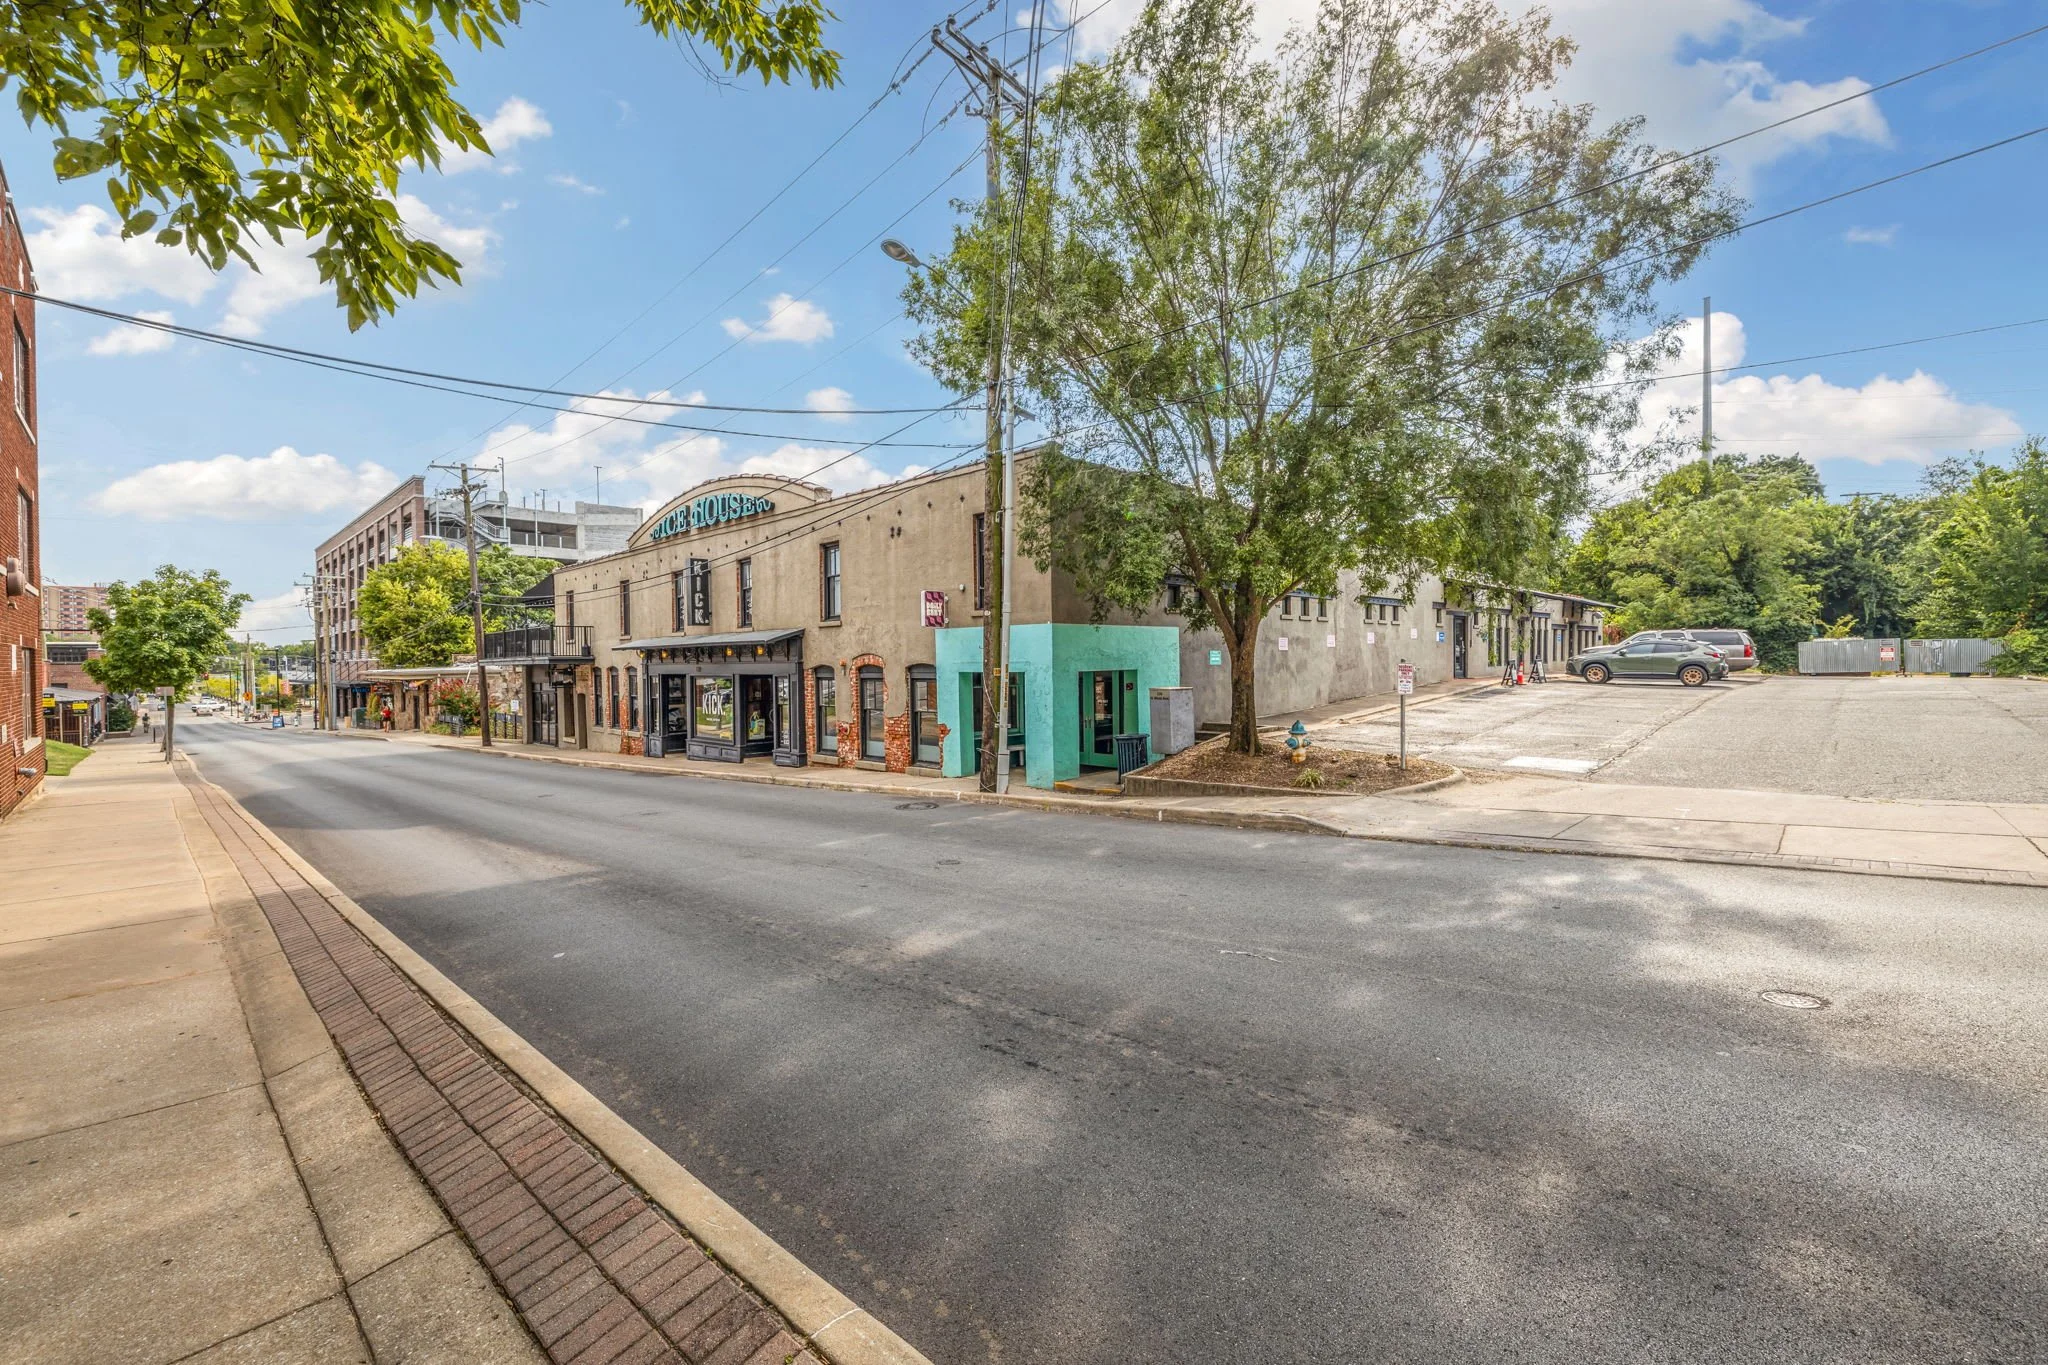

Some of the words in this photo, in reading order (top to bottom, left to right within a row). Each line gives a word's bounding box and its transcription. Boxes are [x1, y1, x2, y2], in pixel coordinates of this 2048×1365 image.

[656, 505, 689, 539] ICE
[691, 492, 756, 529] HOUSE
[702, 694, 726, 716] KICK.
